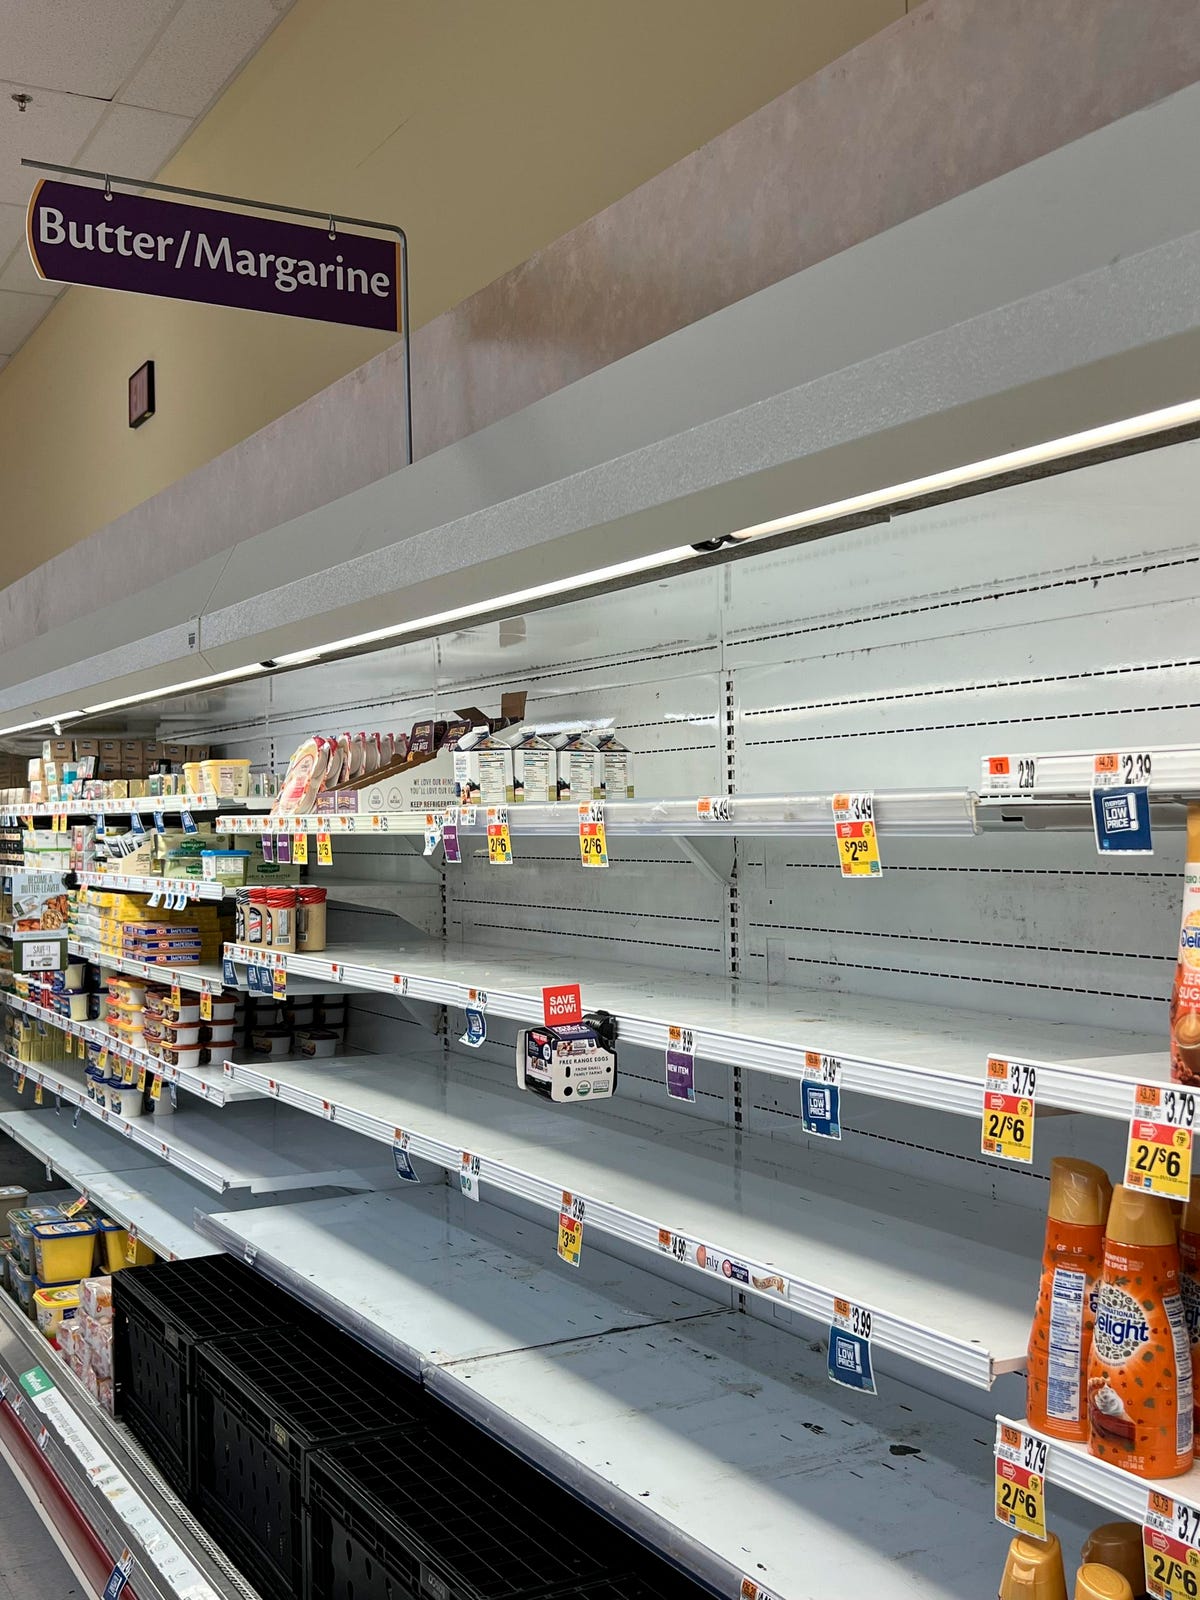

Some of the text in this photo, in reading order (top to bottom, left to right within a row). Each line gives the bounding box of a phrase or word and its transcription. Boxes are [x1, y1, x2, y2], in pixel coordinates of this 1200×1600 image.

[39, 206, 390, 297] Butter/Margarine
[1105, 807, 1128, 820] LOW
[491, 838, 507, 853] 2/$6
[583, 838, 602, 854] 2/$6
[549, 994, 576, 1006] SAVE
[549, 1004, 577, 1015] NOW!
[1011, 1065, 1036, 1096] $3.79
[1165, 1091, 1196, 1126] $3.79
[989, 1114, 1025, 1143] 2/$6
[1135, 1145, 1181, 1177] 2/$6
[852, 1307, 871, 1338] $3.99
[1098, 1314, 1150, 1345] elight
[838, 1348, 854, 1360] LOW
[1025, 1437, 1047, 1473] $3.79
[1002, 1482, 1037, 1518] 2/$6
[1178, 1504, 1200, 1545] $3.7
[1153, 1554, 1198, 1597] 2/$6
